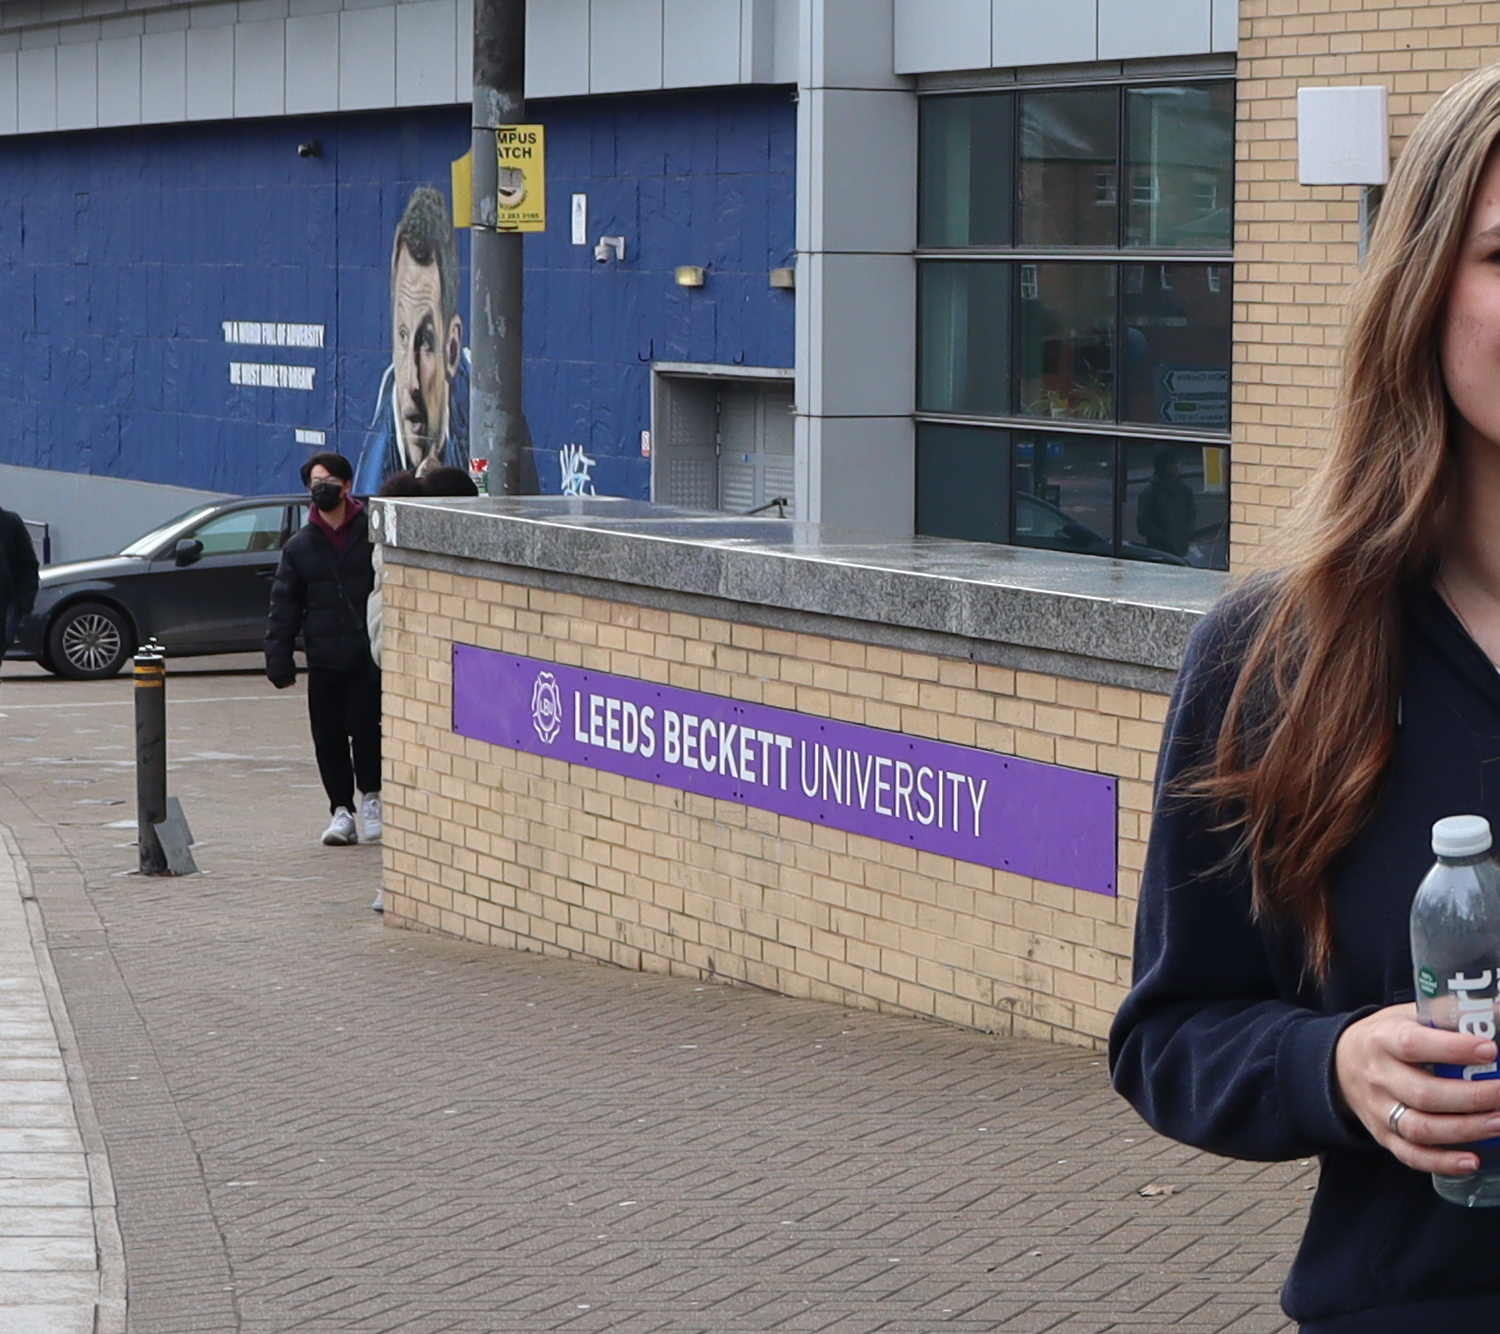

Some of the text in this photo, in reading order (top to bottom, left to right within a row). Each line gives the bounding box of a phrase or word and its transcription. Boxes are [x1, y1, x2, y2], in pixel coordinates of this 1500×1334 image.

[497, 132, 537, 144] MPUS
[497, 147, 532, 159] ATCH
[574, 690, 988, 838] LEEDS BECKETT UNIVERSITY
